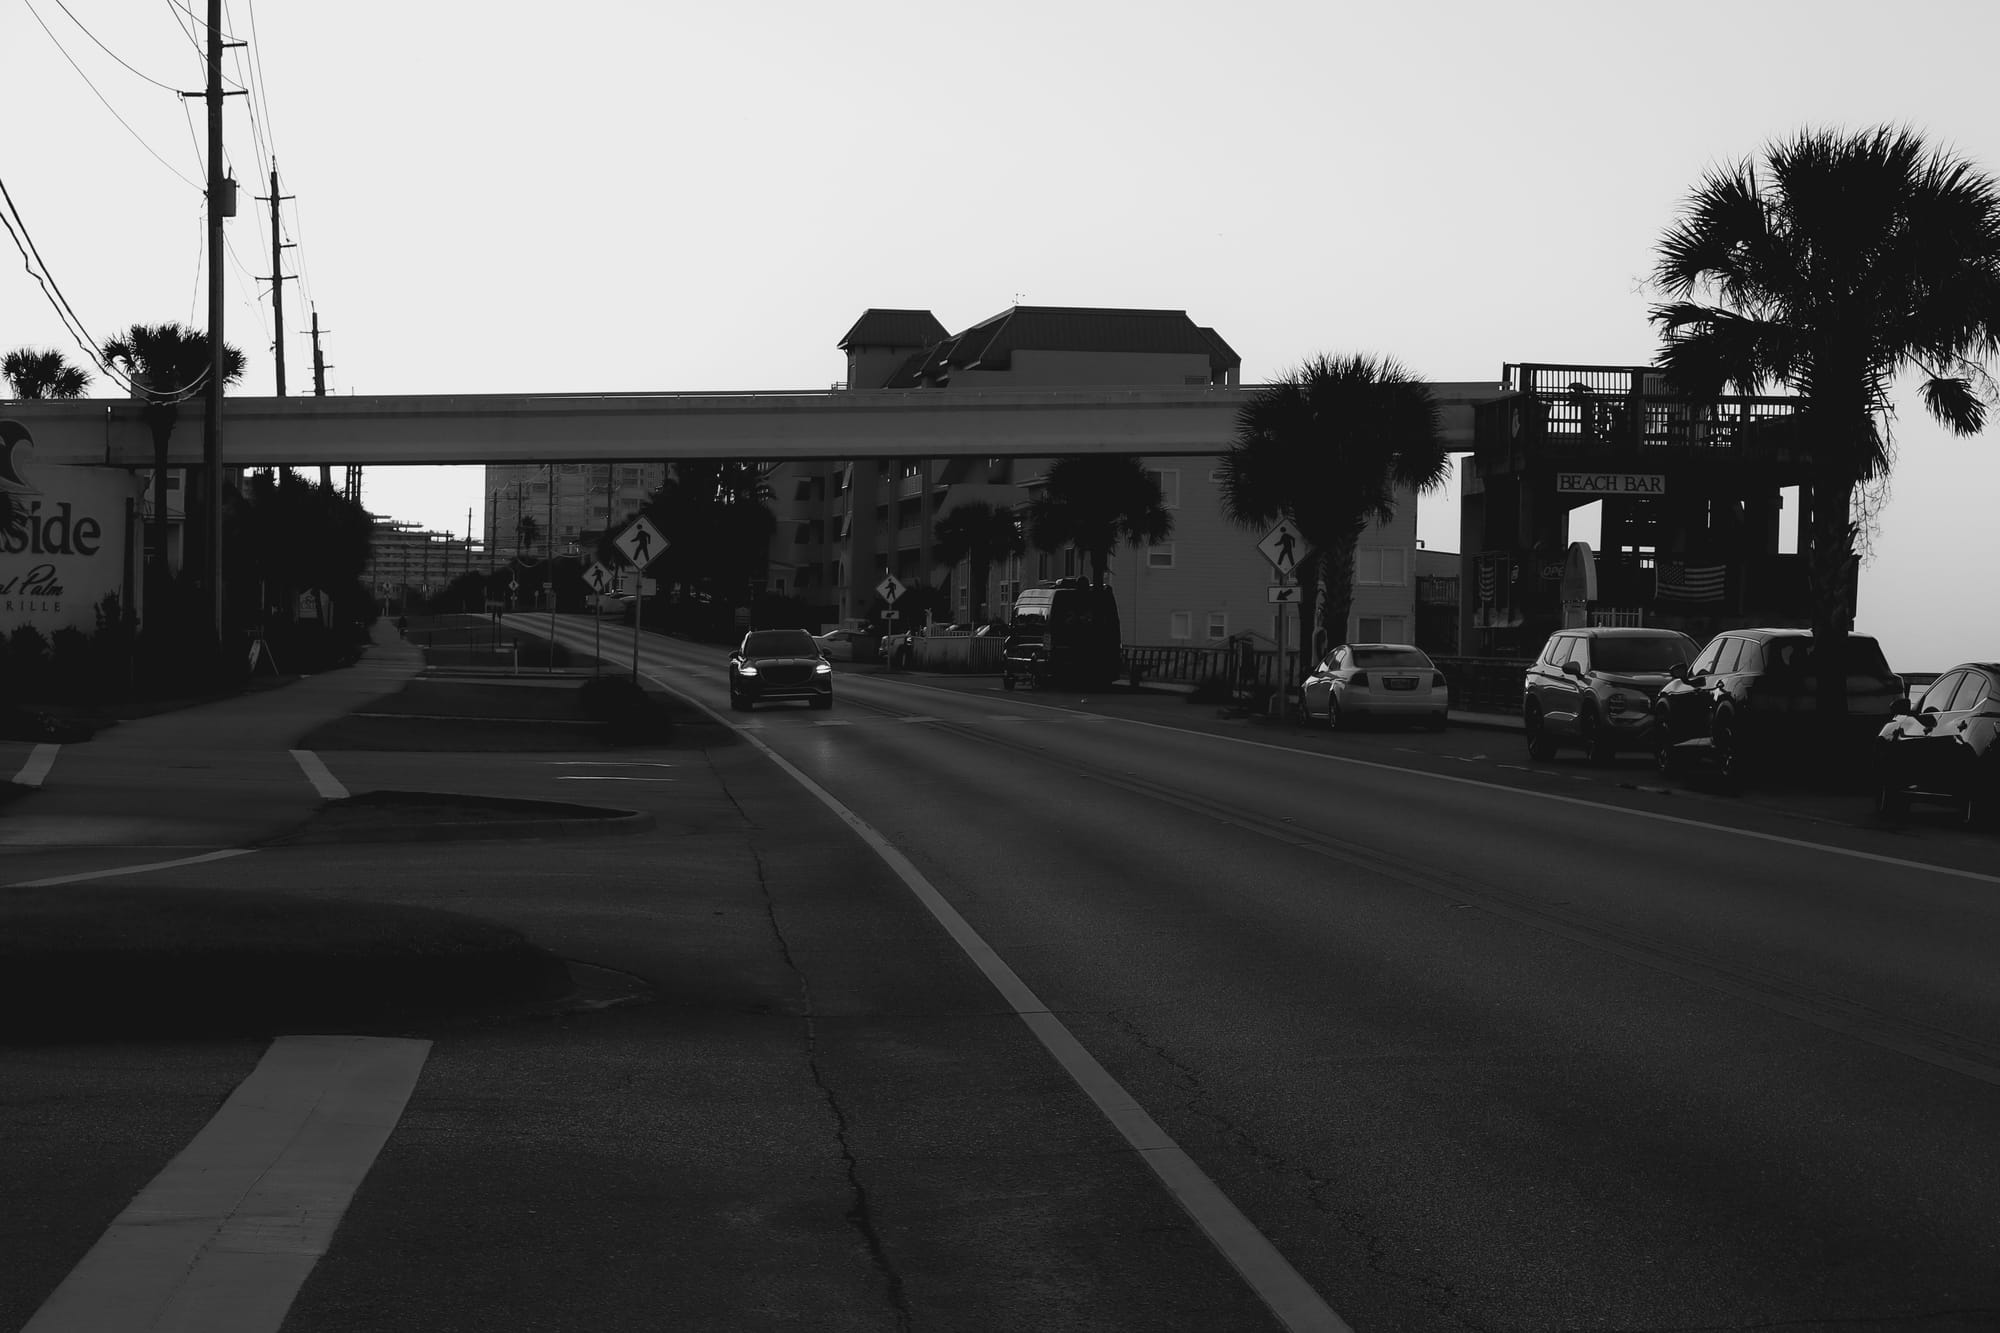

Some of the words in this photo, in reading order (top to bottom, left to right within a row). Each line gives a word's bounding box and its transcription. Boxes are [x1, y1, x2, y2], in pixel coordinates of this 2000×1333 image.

[1559, 475, 1618, 491] BEACH
[1624, 476, 1663, 492] BAR
[0, 501, 101, 556] side
[19, 564, 64, 596] Palm
[1543, 566, 1566, 577] OPE
